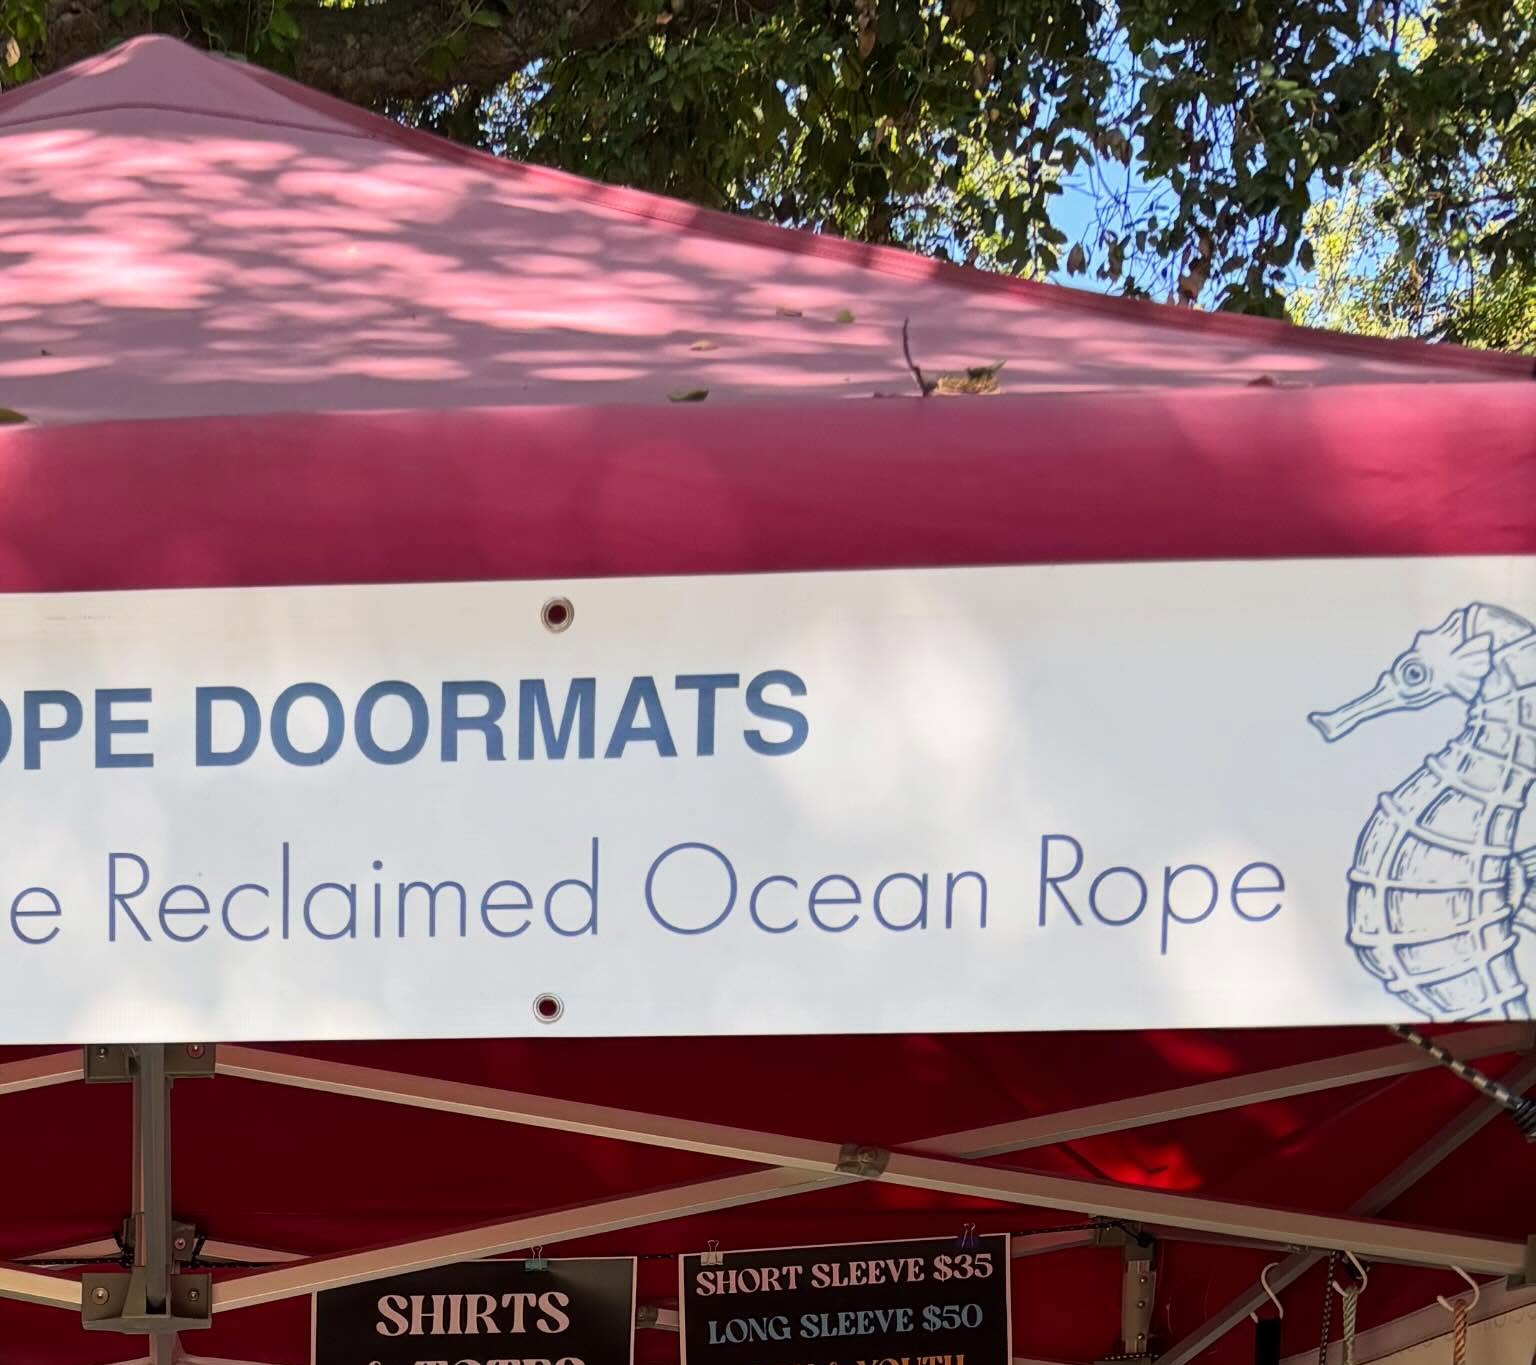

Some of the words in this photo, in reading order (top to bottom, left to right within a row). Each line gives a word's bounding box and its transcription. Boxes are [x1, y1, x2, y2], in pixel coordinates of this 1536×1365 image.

[195, 669, 810, 768] DOORMATS
[107, 836, 600, 945] Reclaimed
[644, 840, 988, 937] Ocean
[1040, 833, 1287, 956] Rope
[695, 1264, 803, 1298] SHORT
[810, 1258, 926, 1289] SLEEVE
[932, 1253, 993, 1283] $35
[376, 1291, 570, 1337] SHIRTS
[708, 1314, 792, 1345] LONG
[799, 1308, 914, 1340] SLEEVE
[921, 1303, 984, 1333] $50
